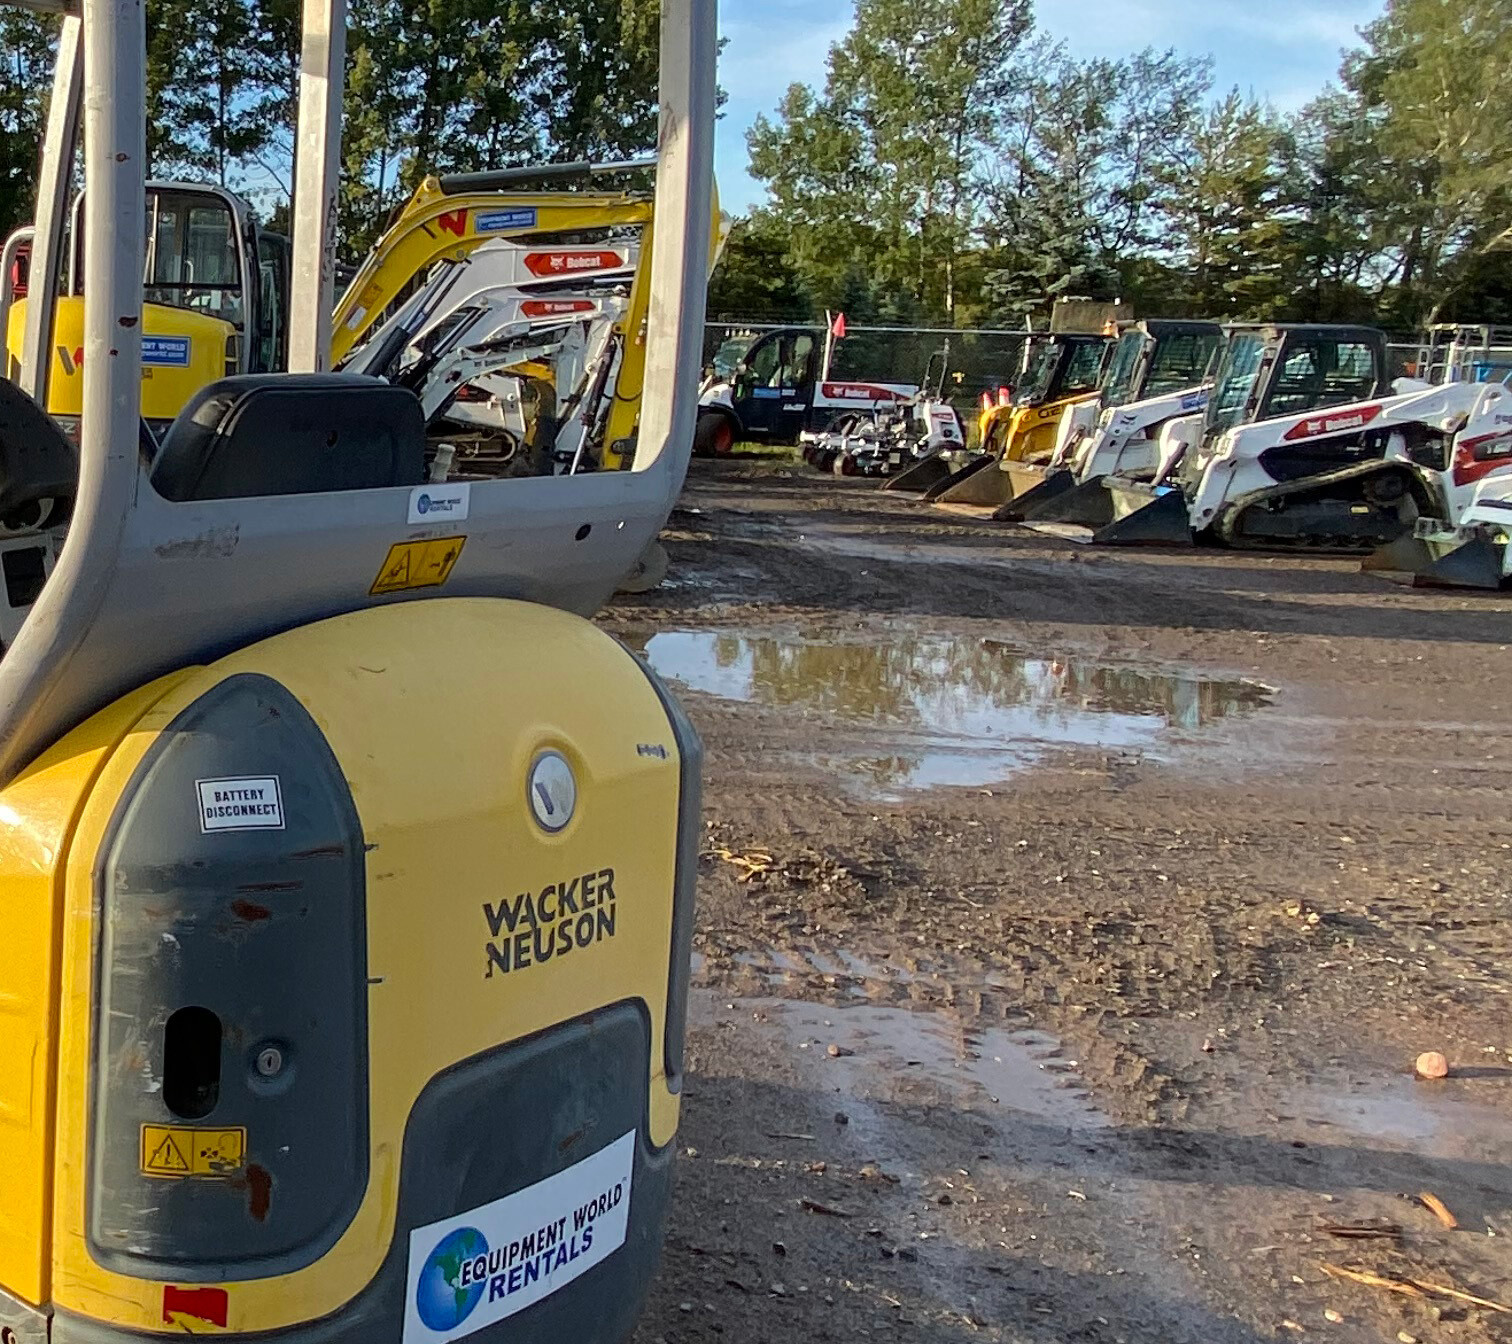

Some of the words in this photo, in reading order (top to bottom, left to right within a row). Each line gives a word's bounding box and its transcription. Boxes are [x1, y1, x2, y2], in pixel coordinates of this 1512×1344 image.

[206, 803, 277, 819] DISCONNECT
[214, 788, 265, 803] BATTERY
[483, 867, 616, 937] WACKER
[484, 902, 616, 980] NEUSON
[460, 1216, 567, 1287] EQUIPMENT
[573, 1183, 623, 1232] WORLD
[488, 1225, 594, 1304] RENTALS
